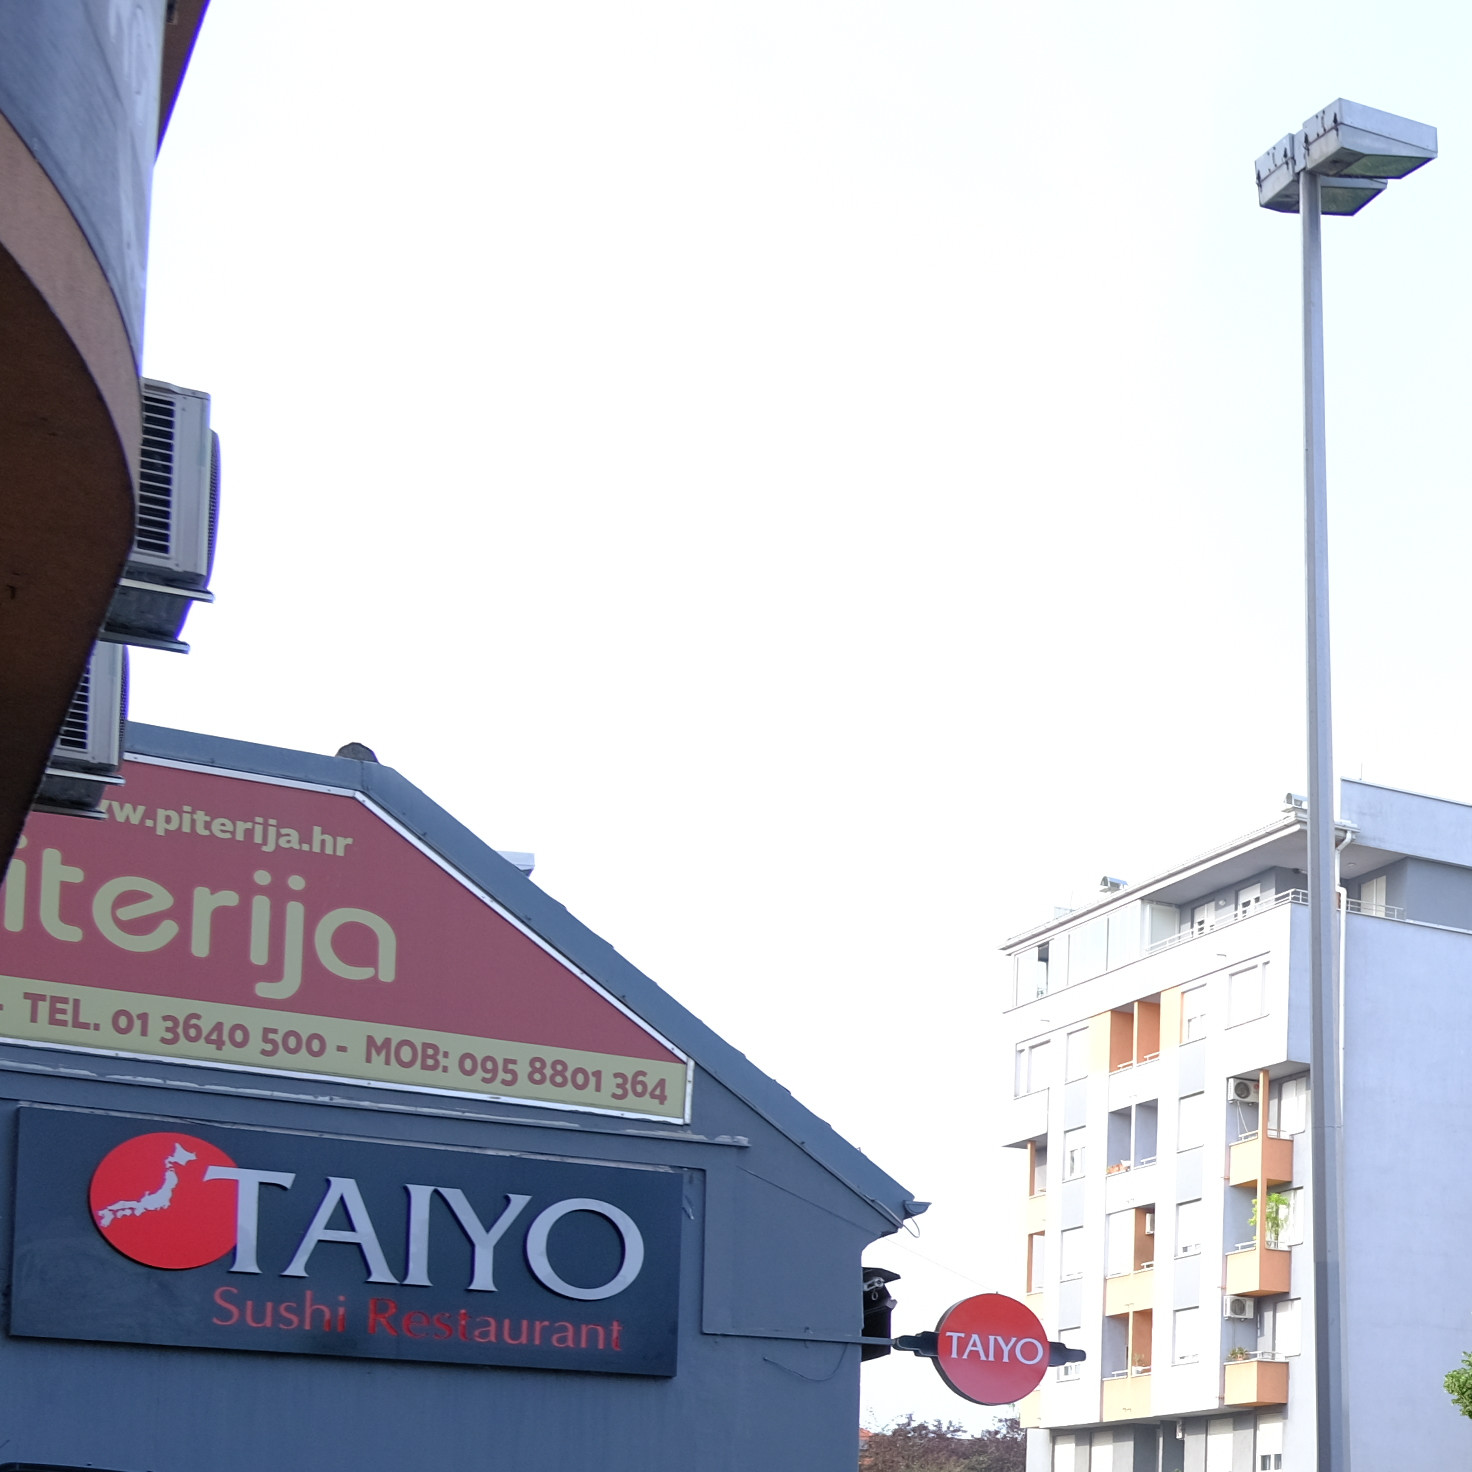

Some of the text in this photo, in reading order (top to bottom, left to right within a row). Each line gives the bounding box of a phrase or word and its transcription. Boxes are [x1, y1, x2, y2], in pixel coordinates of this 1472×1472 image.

[23, 991, 101, 1032] TEL.
[111, 1009, 149, 1037] 01
[160, 1012, 250, 1051] 3640
[260, 1027, 327, 1058] 500
[365, 1034, 449, 1074] MOB:
[458, 1052, 519, 1087] 095
[527, 1056, 602, 1093] 8801
[611, 1070, 668, 1105] 364
[202, 1165, 645, 1302] TAIYO
[211, 1286, 624, 1352] Sushi Restaurant
[945, 1331, 1044, 1365] TAIYO
